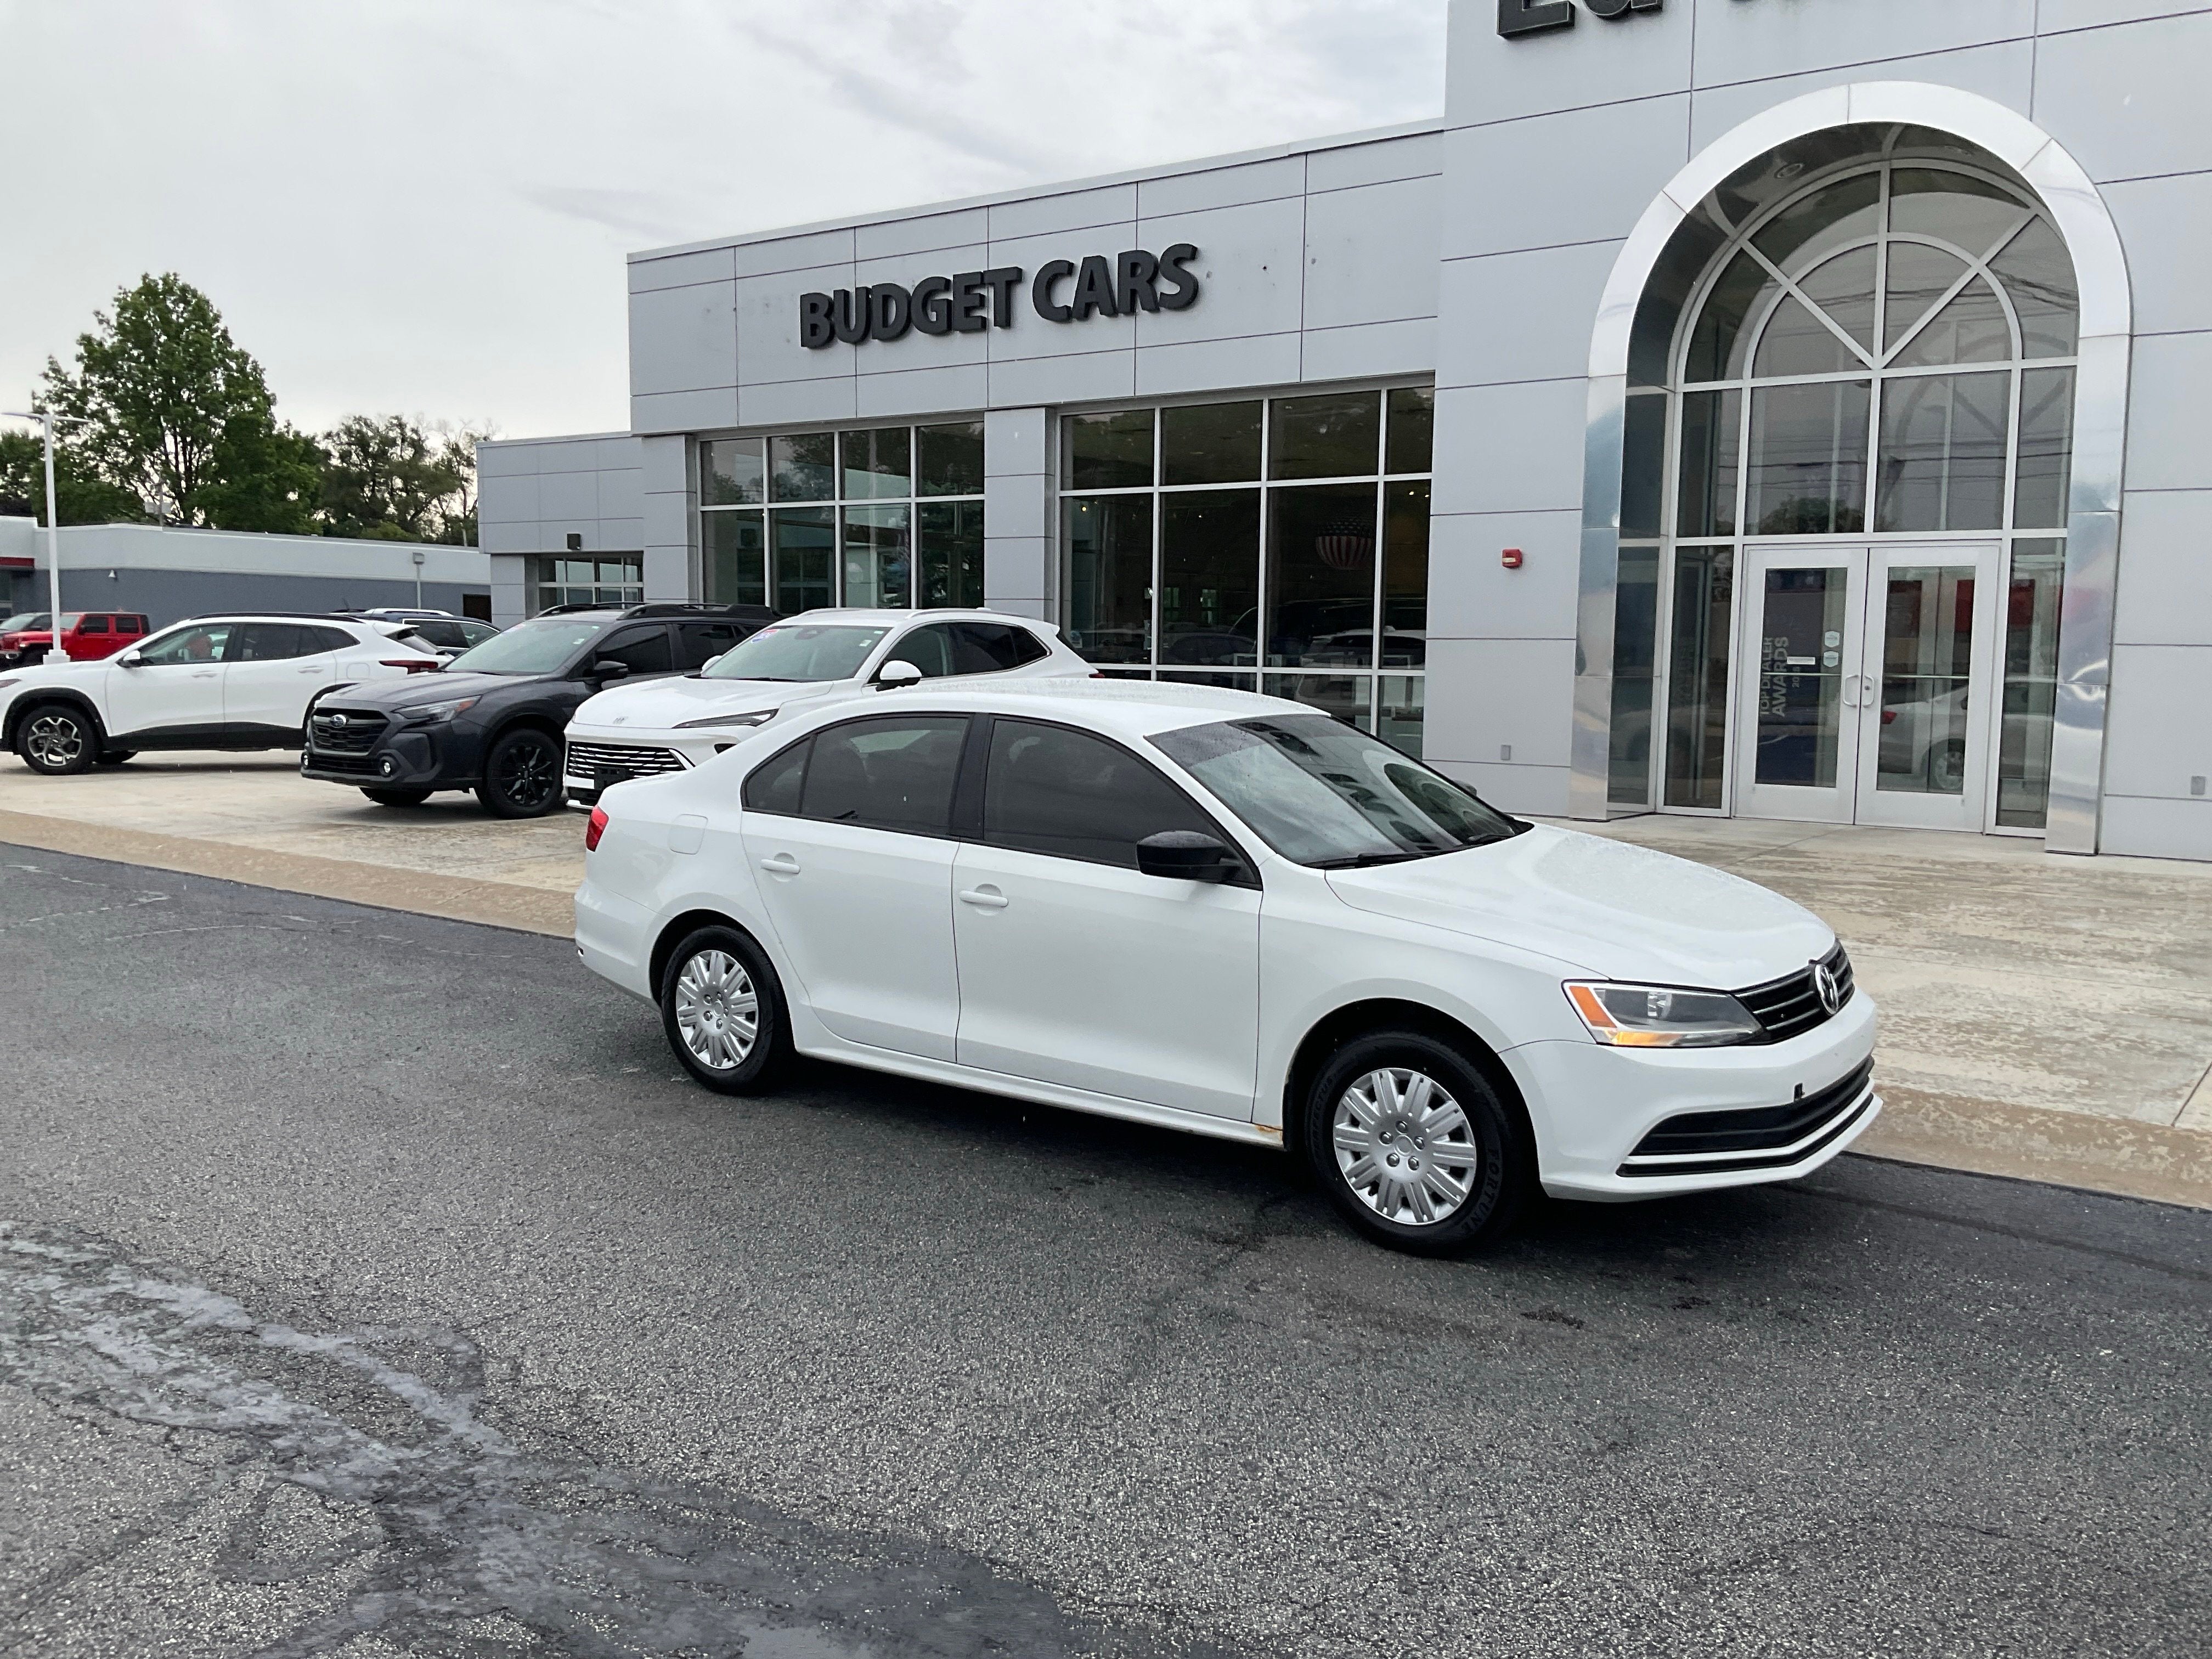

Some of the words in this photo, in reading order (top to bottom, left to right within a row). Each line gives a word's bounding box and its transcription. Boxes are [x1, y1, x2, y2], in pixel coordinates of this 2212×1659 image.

[800, 266, 1023, 349] BUDGET
[1032, 243, 1199, 323] CARS
[1773, 637, 1788, 717] AWARDS
[1460, 1148, 1499, 1234] FORTUNE
